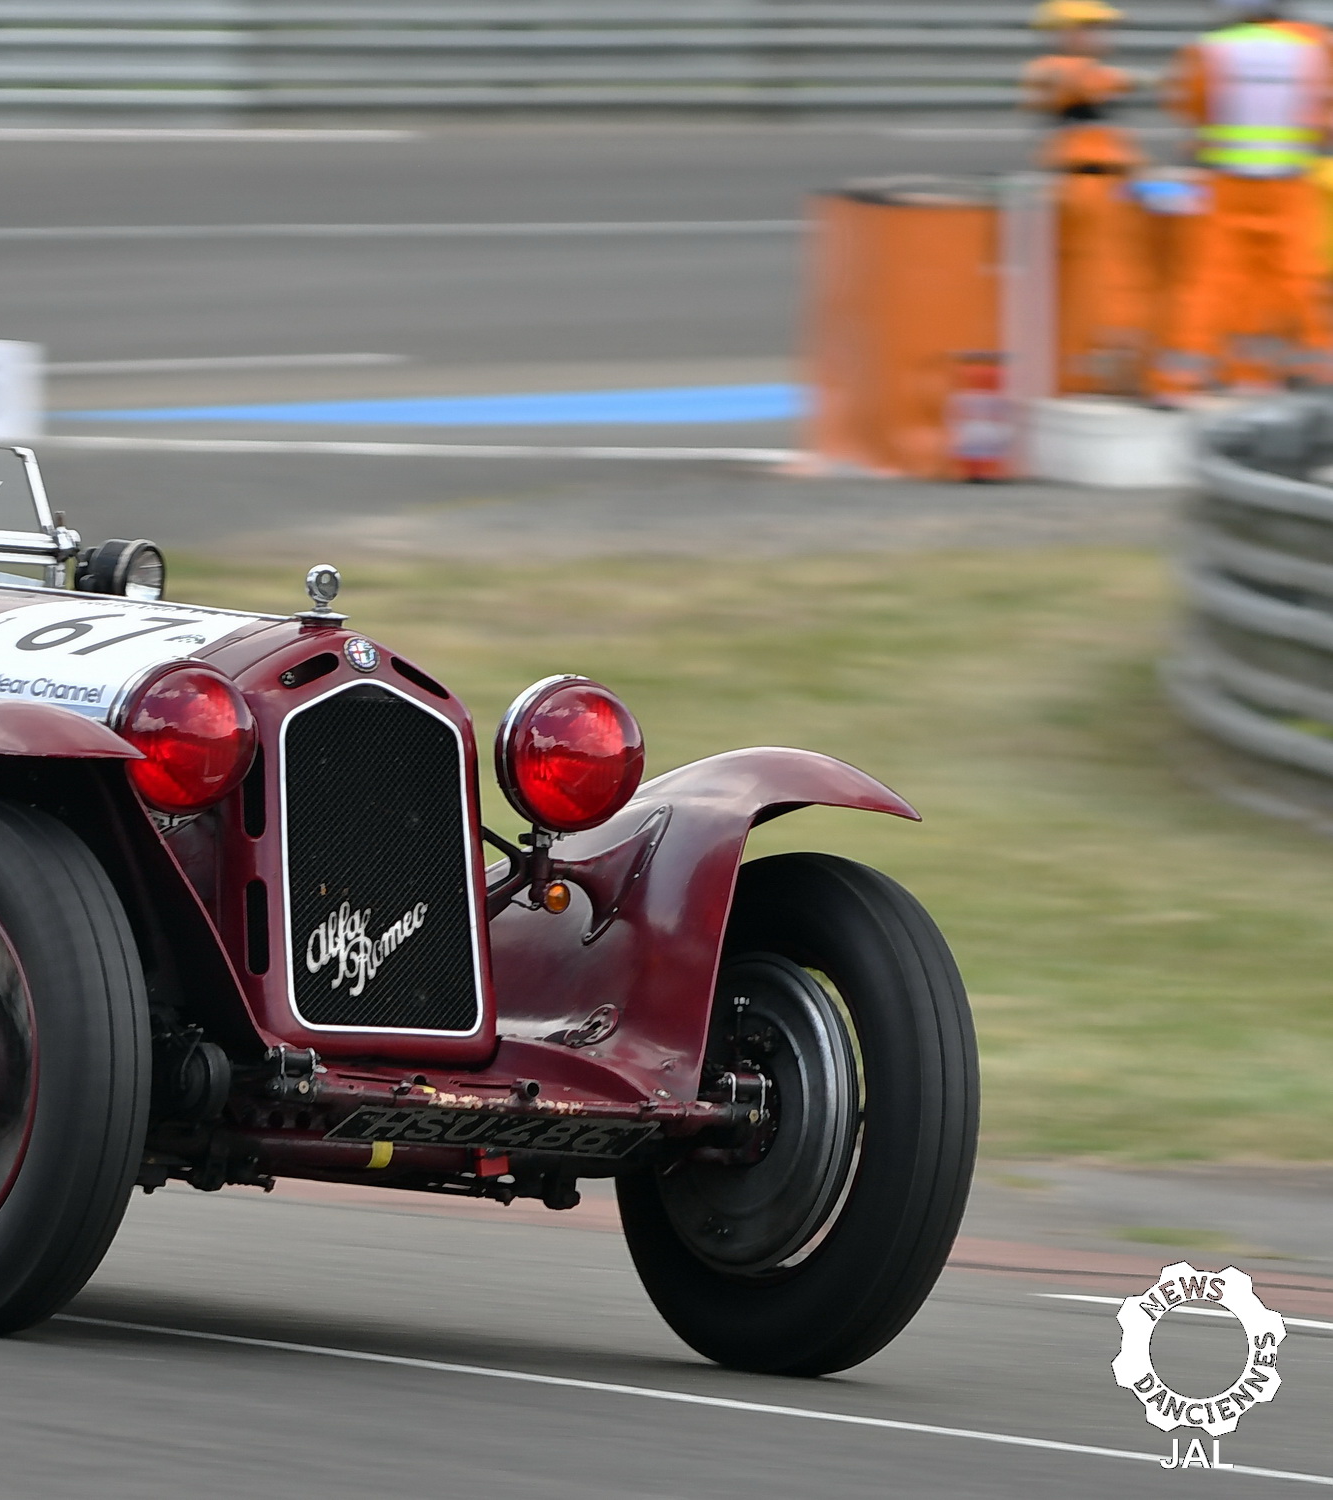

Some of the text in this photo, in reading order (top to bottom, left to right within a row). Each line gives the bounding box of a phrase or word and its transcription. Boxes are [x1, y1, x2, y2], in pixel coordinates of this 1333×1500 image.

[15, 613, 204, 656] 67
[30, 677, 107, 704] Channel
[306, 900, 372, 989] Alfa
[345, 901, 429, 997] Romeo
